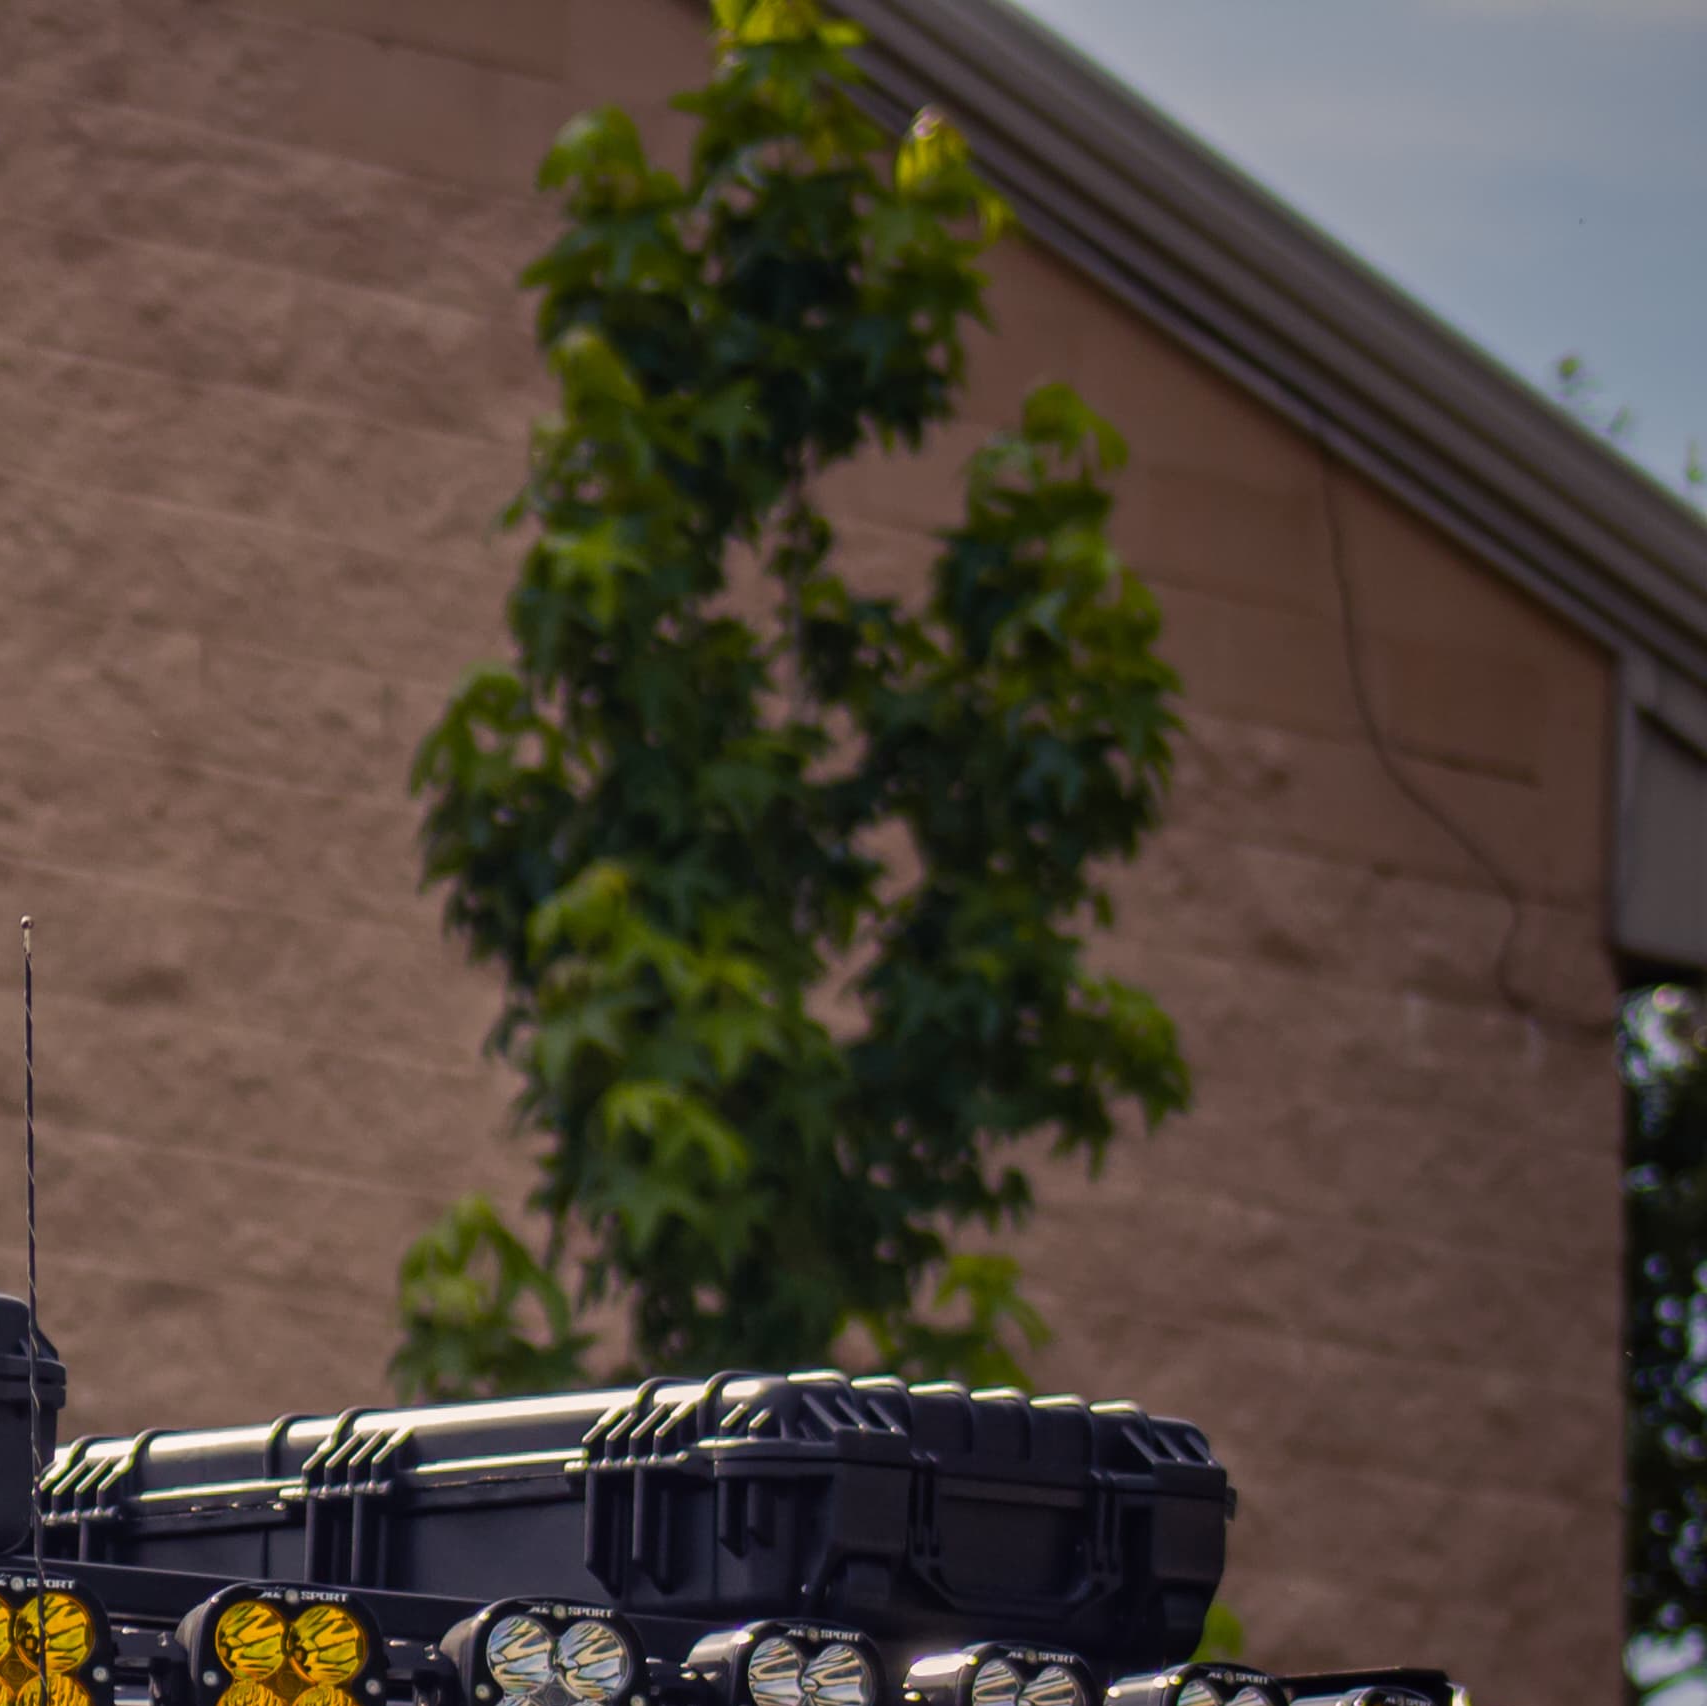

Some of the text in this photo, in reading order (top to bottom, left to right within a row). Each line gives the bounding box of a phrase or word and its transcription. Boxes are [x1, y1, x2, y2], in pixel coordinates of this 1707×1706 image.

[300, 1591, 348, 1602] SPORT
[567, 1607, 613, 1618] SPORT
[819, 1629, 862, 1642] SPORT
[1037, 1652, 1075, 1664] SPORT
[1236, 1673, 1269, 1684] SPORT
